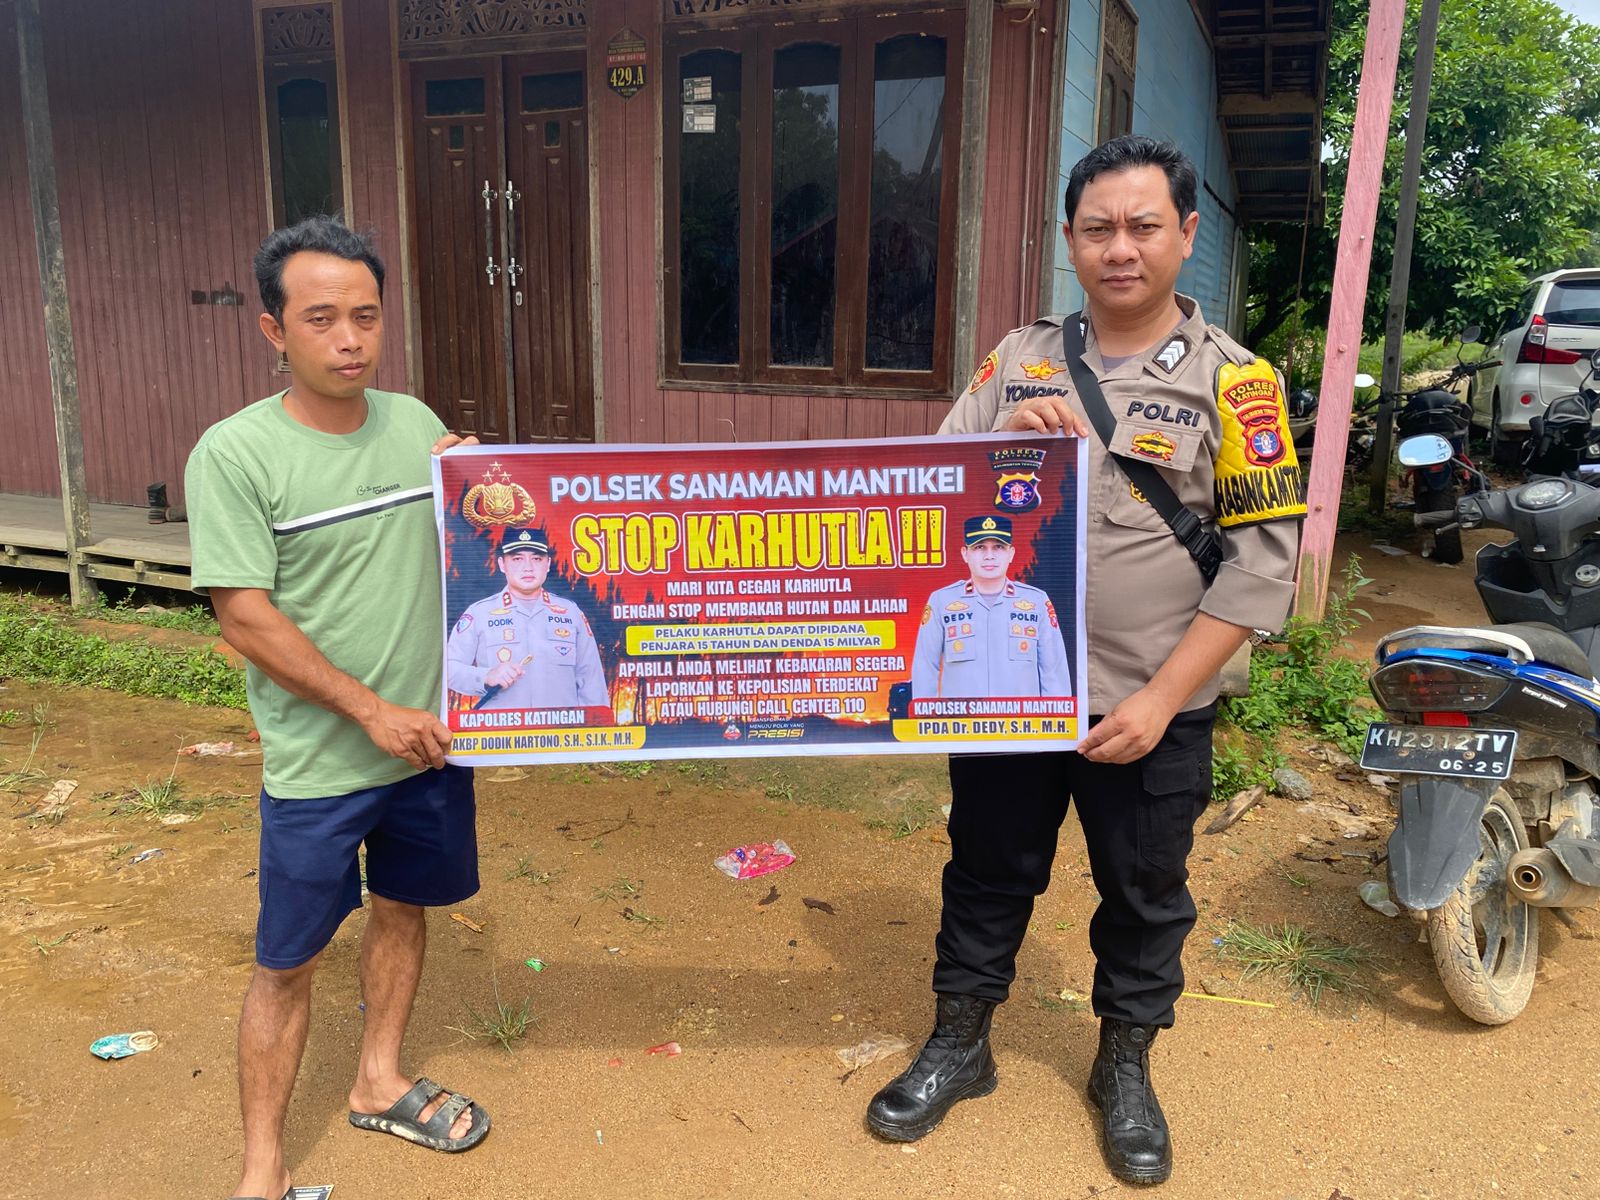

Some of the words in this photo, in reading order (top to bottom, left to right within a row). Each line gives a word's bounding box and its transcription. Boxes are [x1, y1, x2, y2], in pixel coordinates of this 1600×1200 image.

[610, 66, 644, 87] 429.A
[1229, 381, 1275, 399] POLRES
[1127, 400, 1201, 428] POLRI
[550, 474, 664, 502] POLSEK
[669, 470, 815, 499] SANAMAN
[823, 466, 965, 496] MANTIKEI
[572, 513, 681, 575] STOP
[683, 507, 897, 574] KARHUTLA
[667, 581, 702, 596] MARI
[706, 580, 735, 595] KITA
[738, 579, 781, 594] CEGAH
[785, 578, 852, 593] KARHUTLA
[613, 604, 665, 619] DENGAN
[669, 602, 702, 618] STOP
[706, 601, 783, 617] MEMBAKAR
[787, 600, 829, 615] HUTAN
[833, 599, 860, 614] DAN
[864, 599, 908, 613] LAHAN
[944, 612, 974, 623] DEDY
[1010, 612, 1038, 622] POLRI
[488, 618, 514, 627] DODIK
[548, 616, 573, 624] POLRI
[655, 627, 700, 638] PELAKU
[703, 626, 765, 637] KARHUTLA
[768, 625, 806, 635] DAPAT
[808, 624, 866, 634] DIPIDANA
[641, 641, 695, 651] PENJARA
[698, 641, 708, 650] 15
[711, 640, 751, 649] TAHUN
[754, 639, 778, 648] DAN
[781, 638, 821, 648] DENDA
[824, 638, 834, 647] 15
[837, 637, 881, 647] MILYAR
[619, 661, 673, 677] APABILA
[677, 660, 712, 676] ANDA
[716, 659, 772, 674] MELIHAT
[776, 657, 852, 673] KEBAKARAN
[856, 656, 905, 671] SEGERA
[646, 681, 714, 697] LAPORKAN
[718, 680, 734, 696] KE
[738, 679, 811, 694] KEPOLISIAN
[815, 677, 879, 692] TERDEKAT
[661, 702, 694, 717] ATAU
[698, 700, 753, 716] HUBUNGI
[757, 699, 789, 714] CALL
[792, 698, 841, 714] CENTER
[844, 698, 866, 713] 110
[914, 701, 967, 715] KAPOLSEK
[969, 701, 1021, 714] SANAMAN
[1023, 700, 1074, 714] MANTIKEI
[459, 713, 523, 728] KAPOLRES
[524, 710, 585, 725] KATINGAN
[919, 722, 949, 735] IPDA
[952, 722, 970, 735] Dr.
[973, 721, 1008, 735] DEDY,
[1042, 720, 1070, 733] M.H.
[452, 737, 479, 751] AKBP
[481, 736, 512, 750] DODIK
[514, 735, 563, 749] HARTONO,
[614, 732, 634, 745] M.H.
[747, 728, 805, 738] PRESISI
